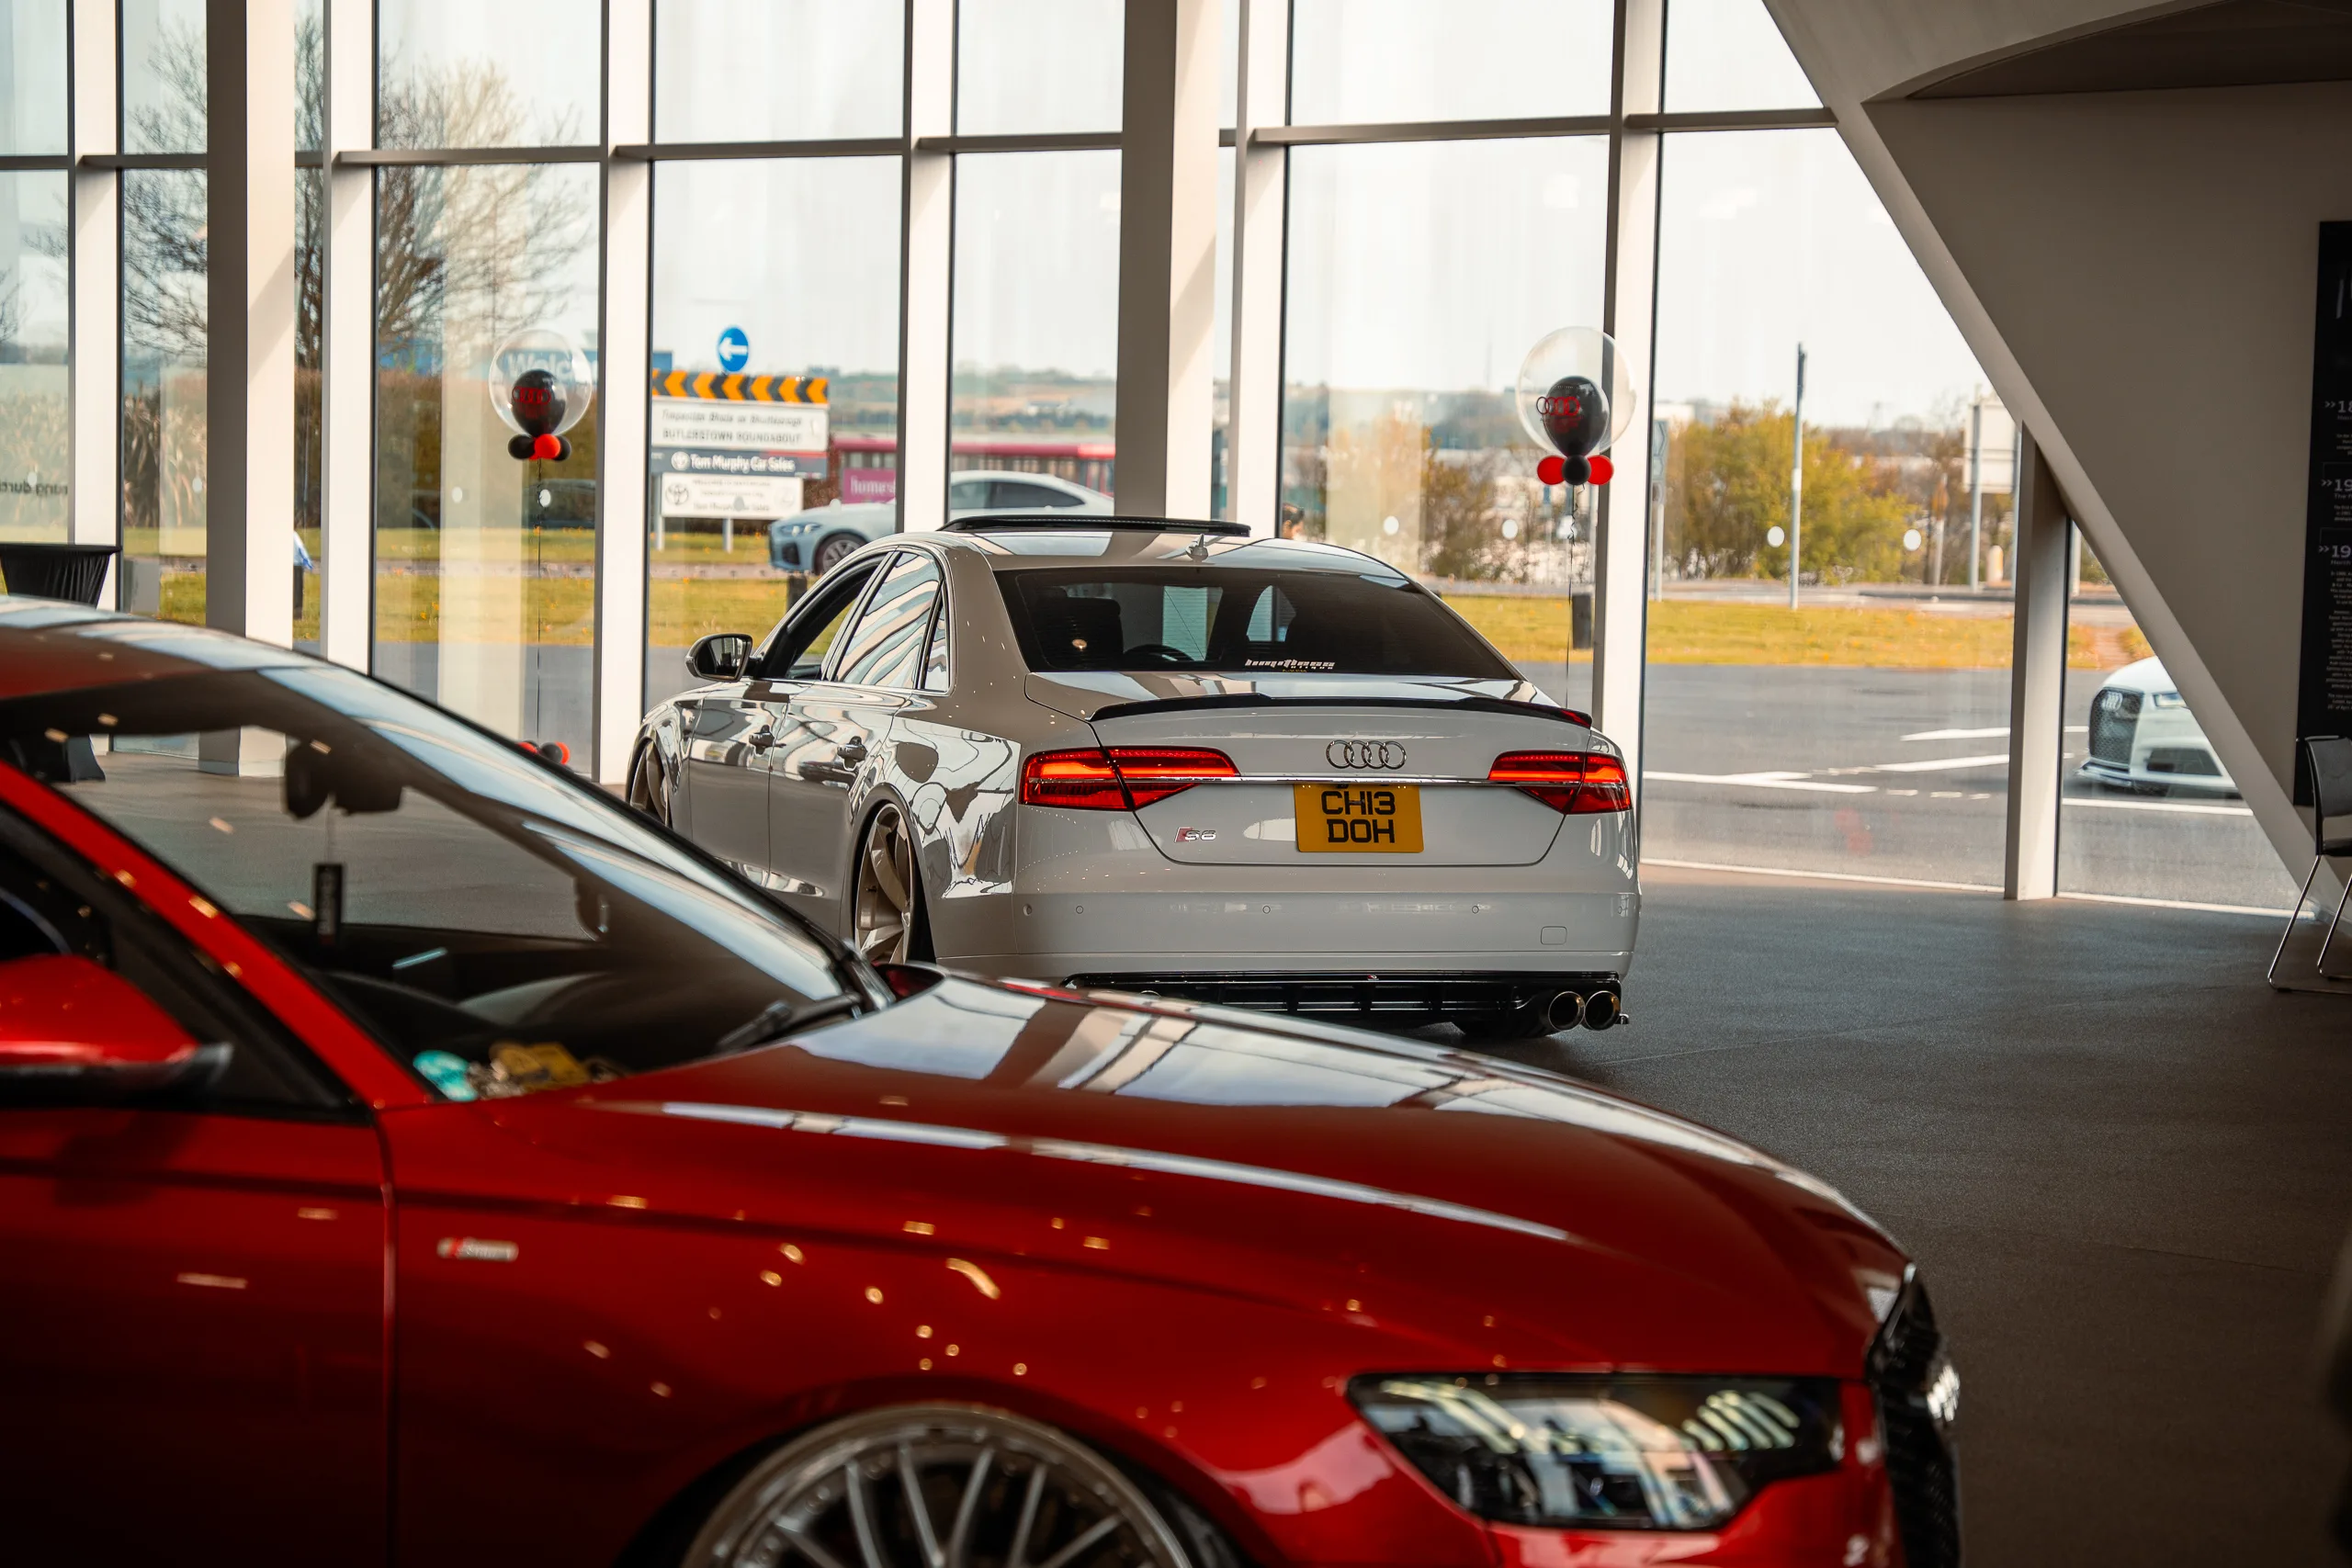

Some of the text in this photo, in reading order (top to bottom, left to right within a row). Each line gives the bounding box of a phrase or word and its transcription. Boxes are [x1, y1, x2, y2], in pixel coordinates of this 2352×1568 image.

[662, 430, 801, 444] BUTLERSTOWN ROUNDABOUT
[690, 454, 796, 474] Tom Murphy Car Sales
[850, 475, 896, 495] homes
[2331, 545, 2352, 558] 19
[1327, 819, 1396, 843] DOH
